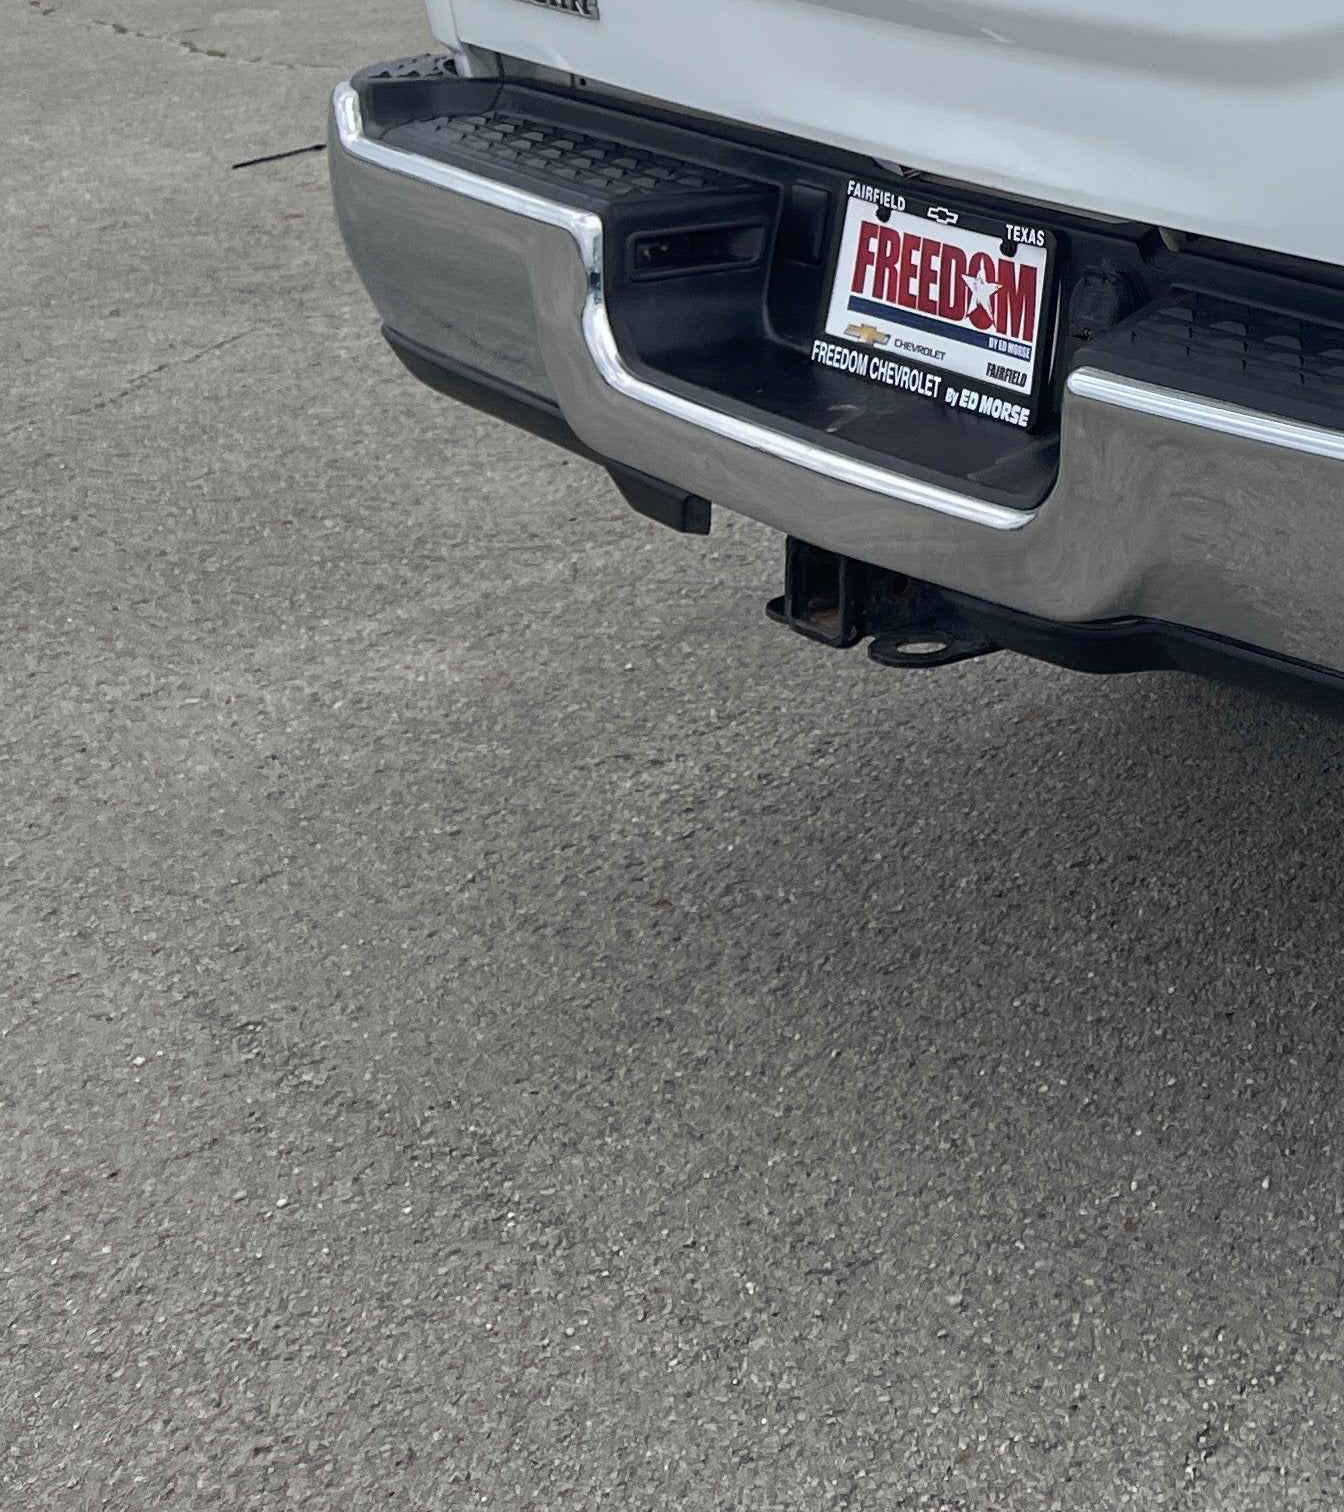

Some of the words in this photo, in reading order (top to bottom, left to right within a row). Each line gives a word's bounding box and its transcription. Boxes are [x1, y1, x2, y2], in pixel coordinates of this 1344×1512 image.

[847, 180, 906, 211] FAIRFIELD
[1006, 224, 1045, 246] TEXAS
[851, 220, 1037, 342] FREEDOM
[894, 339, 946, 360] CHEVROLET
[811, 340, 868, 377] FREEDOM
[869, 354, 941, 399] CHEVROLET
[959, 389, 979, 410] ED
[979, 395, 1031, 427] MORSE
[986, 362, 1027, 387] FAIRFIELD
